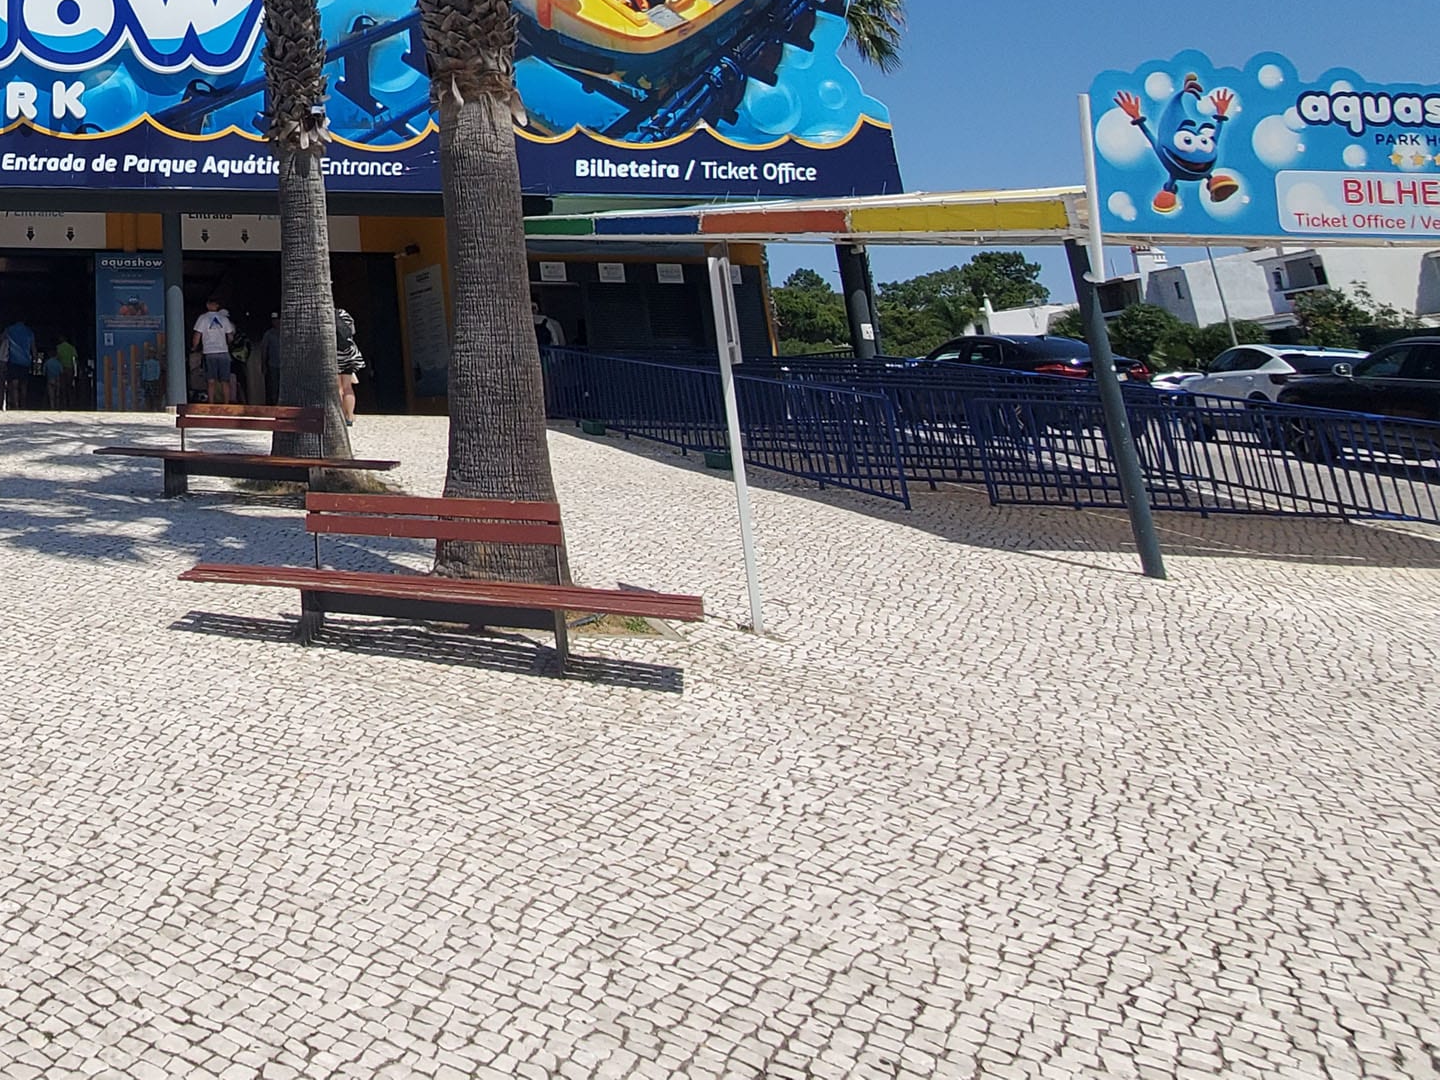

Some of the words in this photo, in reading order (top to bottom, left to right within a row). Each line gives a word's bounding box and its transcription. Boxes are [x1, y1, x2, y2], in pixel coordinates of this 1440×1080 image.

[1375, 134, 1420, 146] PARK
[1426, 135, 1440, 146] H
[2, 153, 86, 171] Entrada
[91, 154, 118, 172] de
[123, 155, 197, 177] Parque
[202, 154, 279, 178] Aquátic
[320, 157, 403, 176] Entrance
[575, 159, 680, 178] Bilheteira
[684, 159, 695, 180] /
[700, 161, 758, 180] Ticket
[763, 162, 817, 184] Office
[1294, 213, 1348, 228] Ticket
[1353, 214, 1406, 229] Office
[101, 258, 162, 269] aquashow
